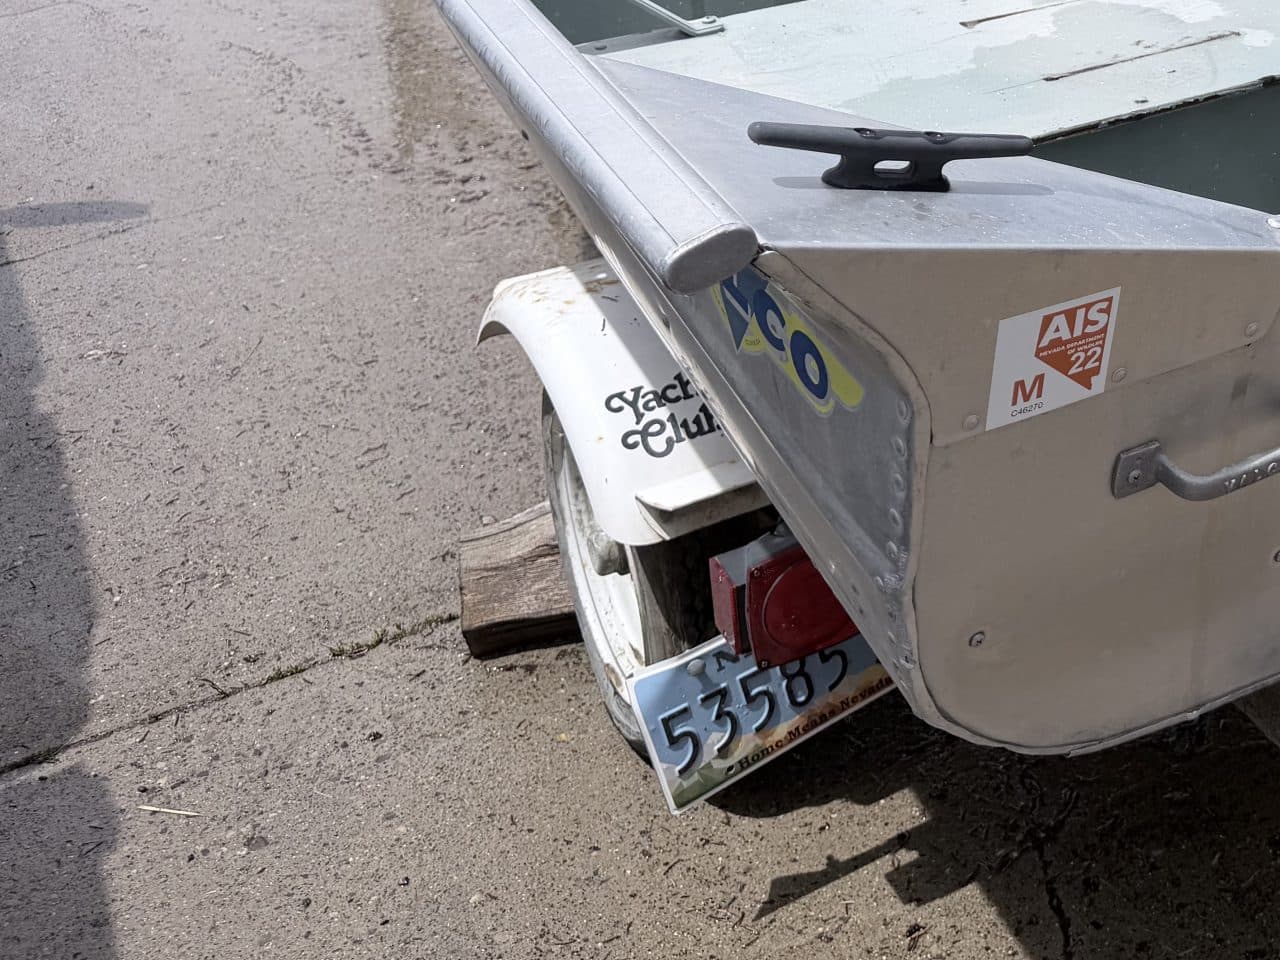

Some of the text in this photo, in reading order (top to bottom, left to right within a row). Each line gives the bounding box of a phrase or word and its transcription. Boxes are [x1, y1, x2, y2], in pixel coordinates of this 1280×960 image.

[1039, 301, 1109, 348] AIS
[1039, 333, 1105, 357] NEVADA DEPARTMENT
[1067, 346, 1102, 376] 22
[1077, 340, 1103, 352] WILDLIFE
[605, 372, 699, 425] Yach
[1011, 373, 1045, 407] M
[1010, 401, 1044, 417] C46270
[738, 674, 895, 772] Home Means Nevada
